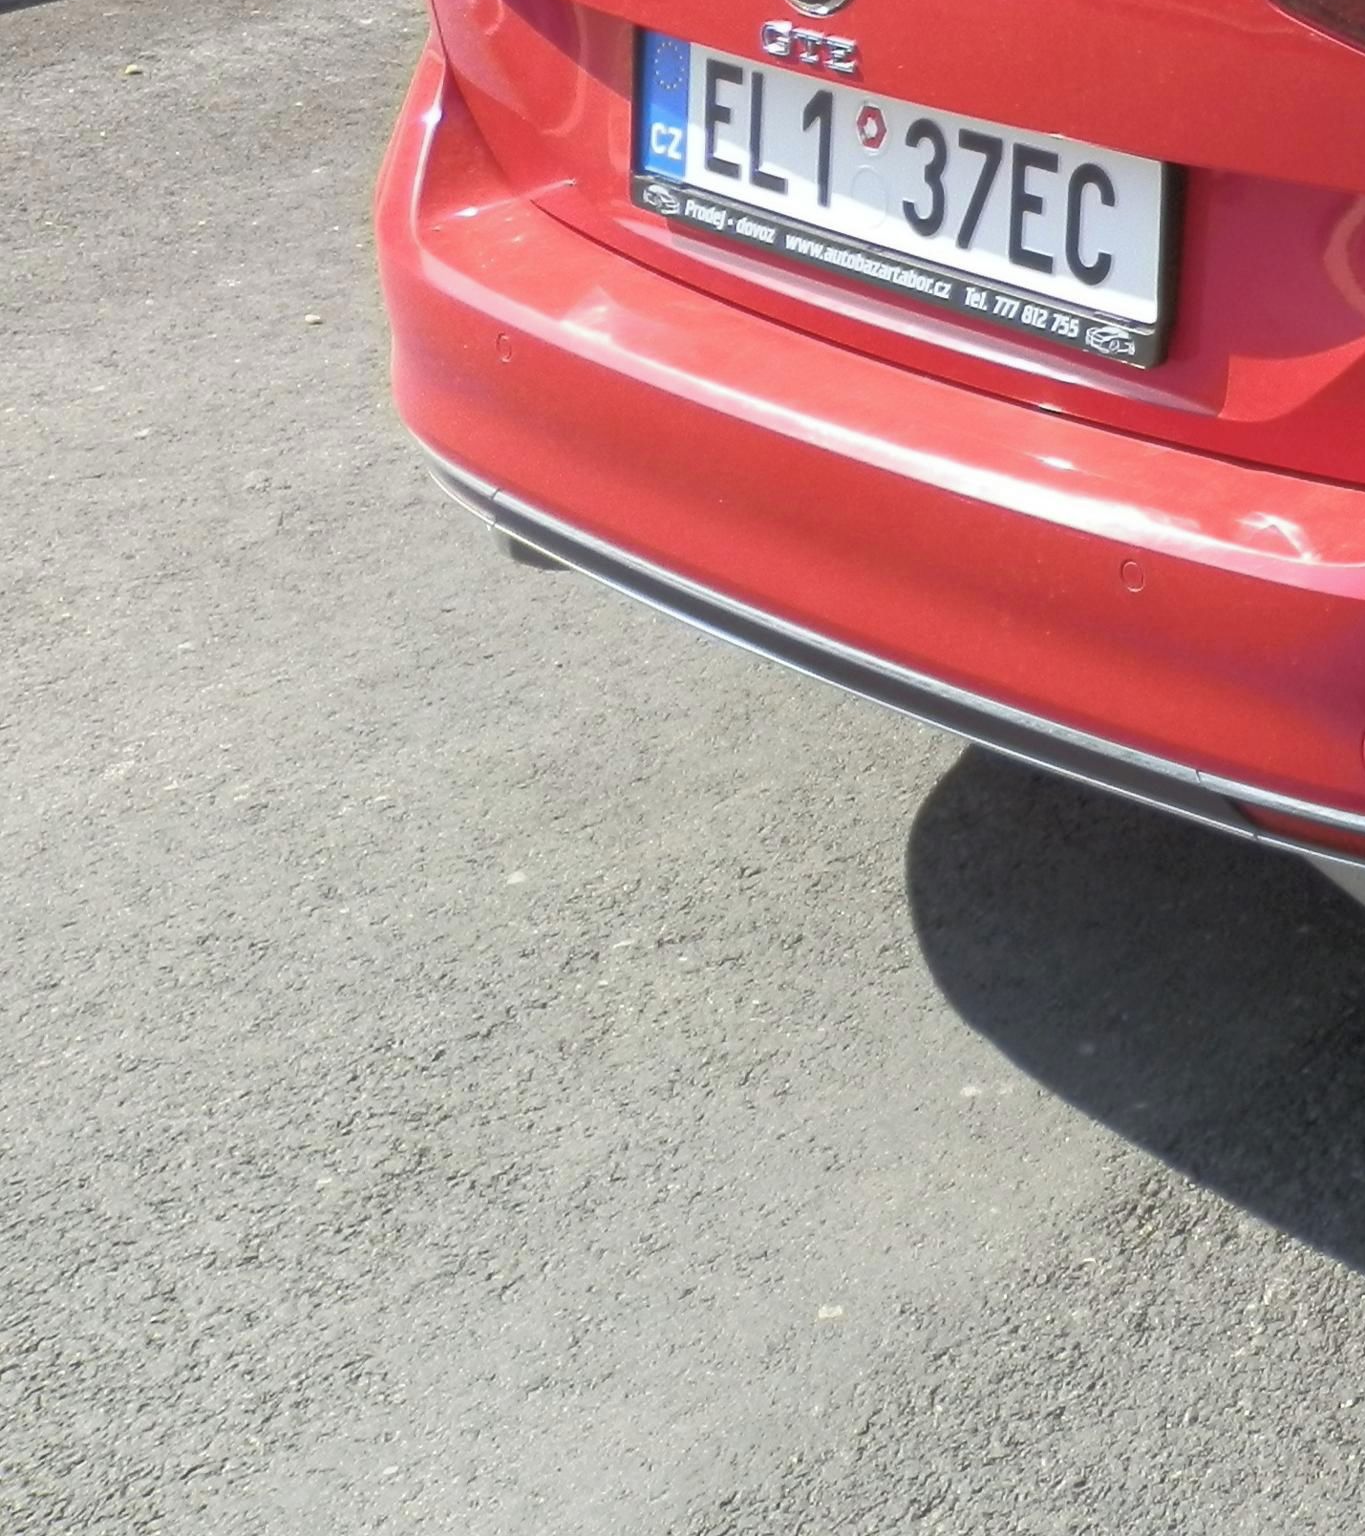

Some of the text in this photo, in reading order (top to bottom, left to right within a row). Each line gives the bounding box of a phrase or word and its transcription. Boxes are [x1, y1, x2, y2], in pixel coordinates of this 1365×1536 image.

[650, 121, 683, 160] CZ
[705, 58, 1117, 286] EL1 37EC
[684, 199, 726, 231] Prodej
[736, 216, 776, 244] dovoz
[785, 232, 952, 299] www.autobazartabor.cz
[965, 286, 988, 309] Tel.
[1020, 304, 1049, 328] 812
[1050, 313, 1080, 338] 755
